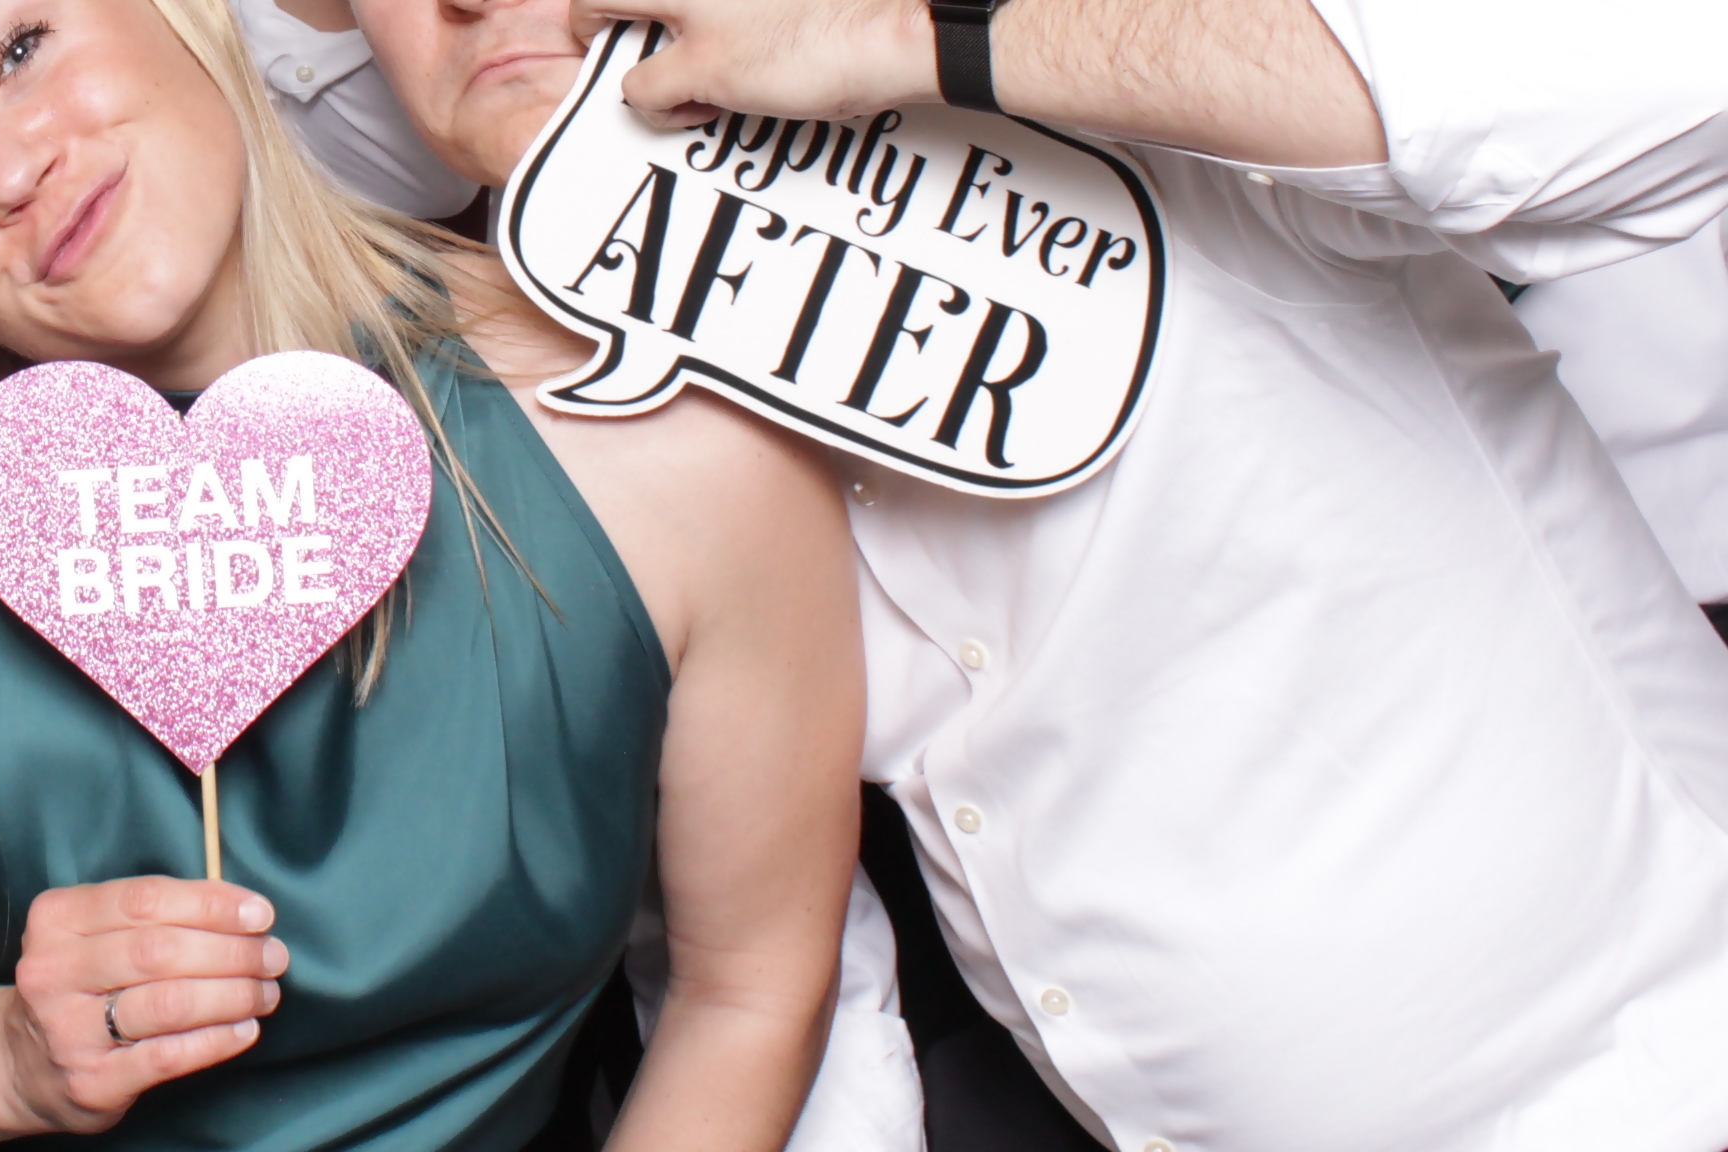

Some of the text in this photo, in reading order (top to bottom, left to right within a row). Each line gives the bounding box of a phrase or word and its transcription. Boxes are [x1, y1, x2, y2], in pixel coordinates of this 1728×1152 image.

[933, 144, 1136, 288] Ever
[563, 161, 1048, 468] AFTER
[57, 454, 317, 536] TEAM
[56, 535, 337, 617] BRIDE
